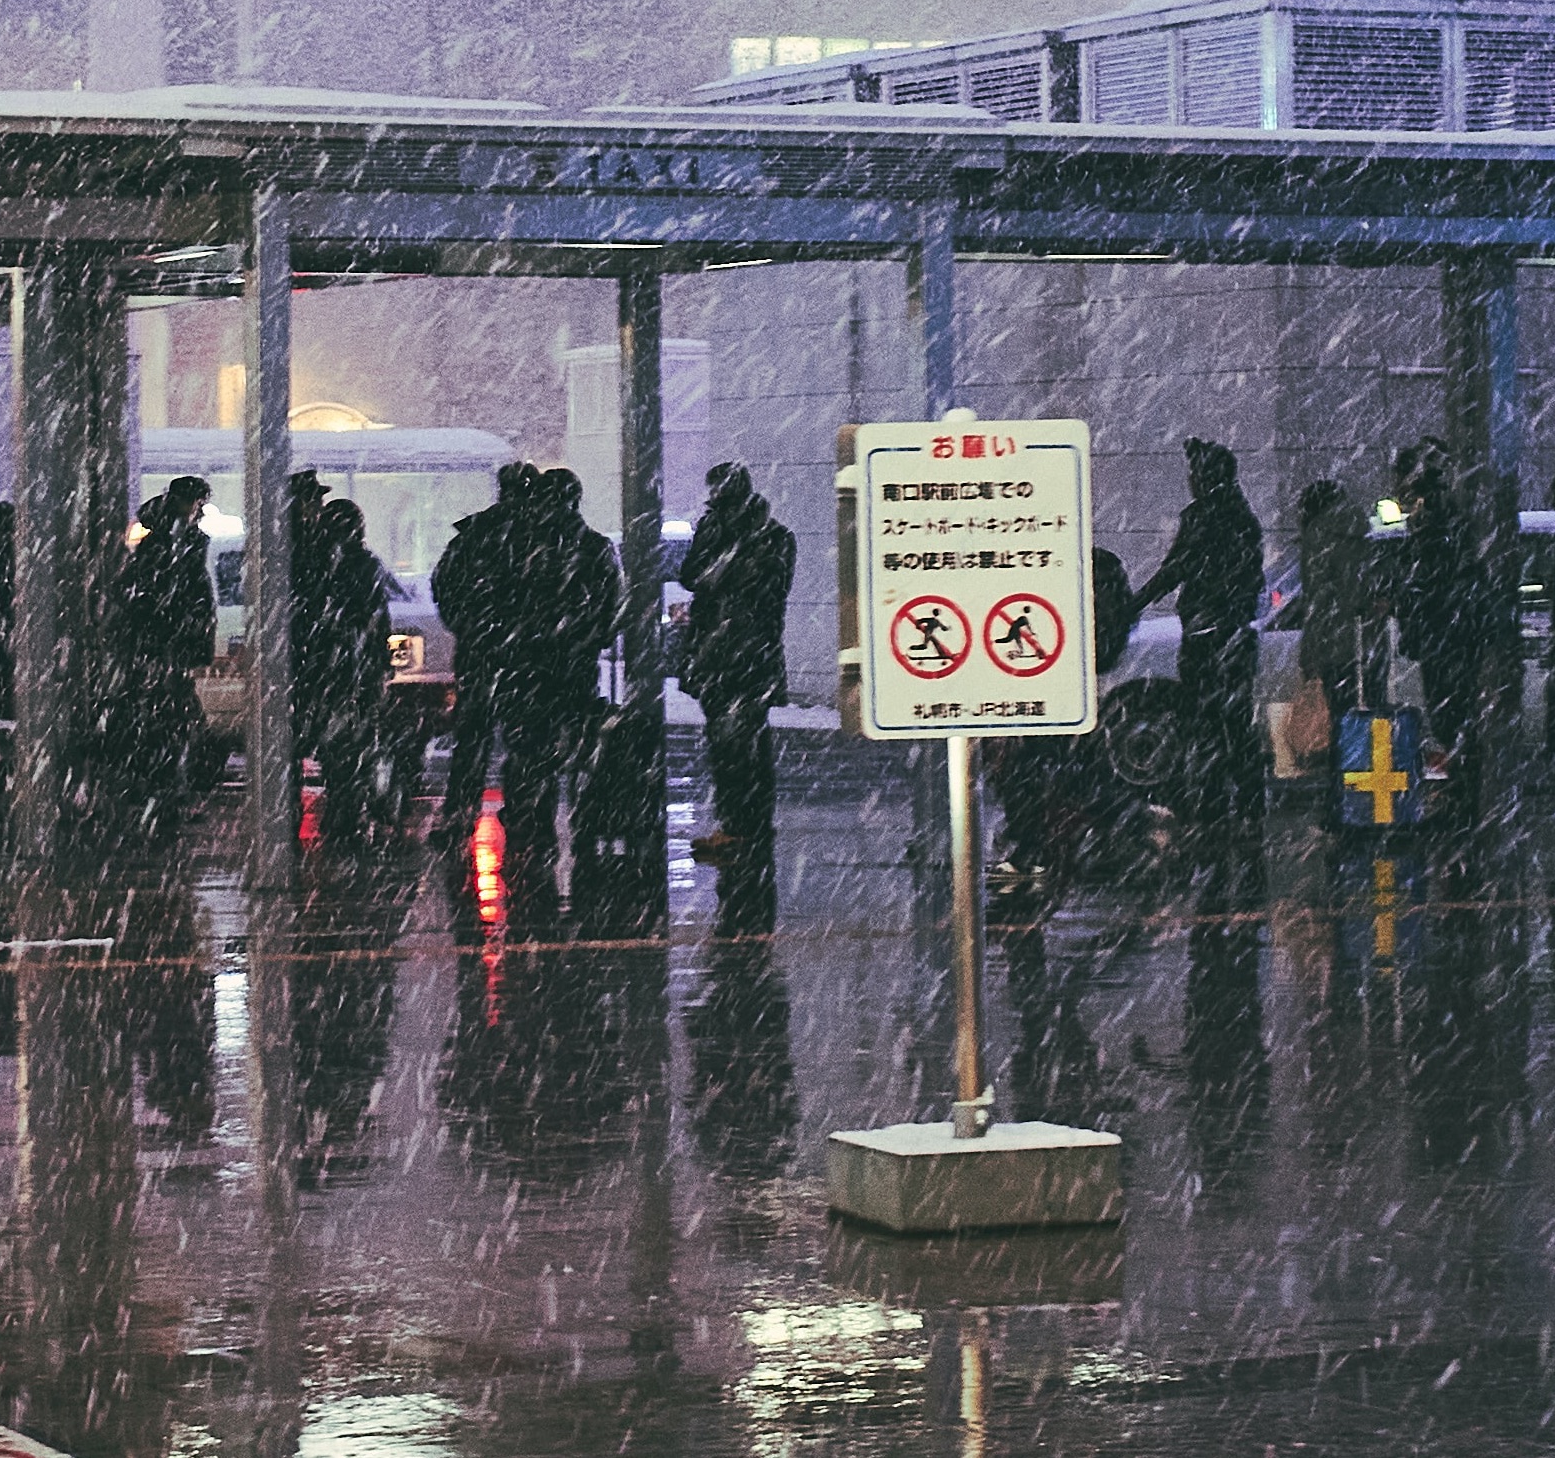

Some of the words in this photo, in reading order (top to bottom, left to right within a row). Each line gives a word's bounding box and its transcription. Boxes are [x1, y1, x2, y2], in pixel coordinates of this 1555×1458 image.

[931, 435, 1016, 459] お願い
[882, 481, 1033, 501] 南口駅前広場での
[883, 550, 1064, 571] 等の使用は禁止です。
